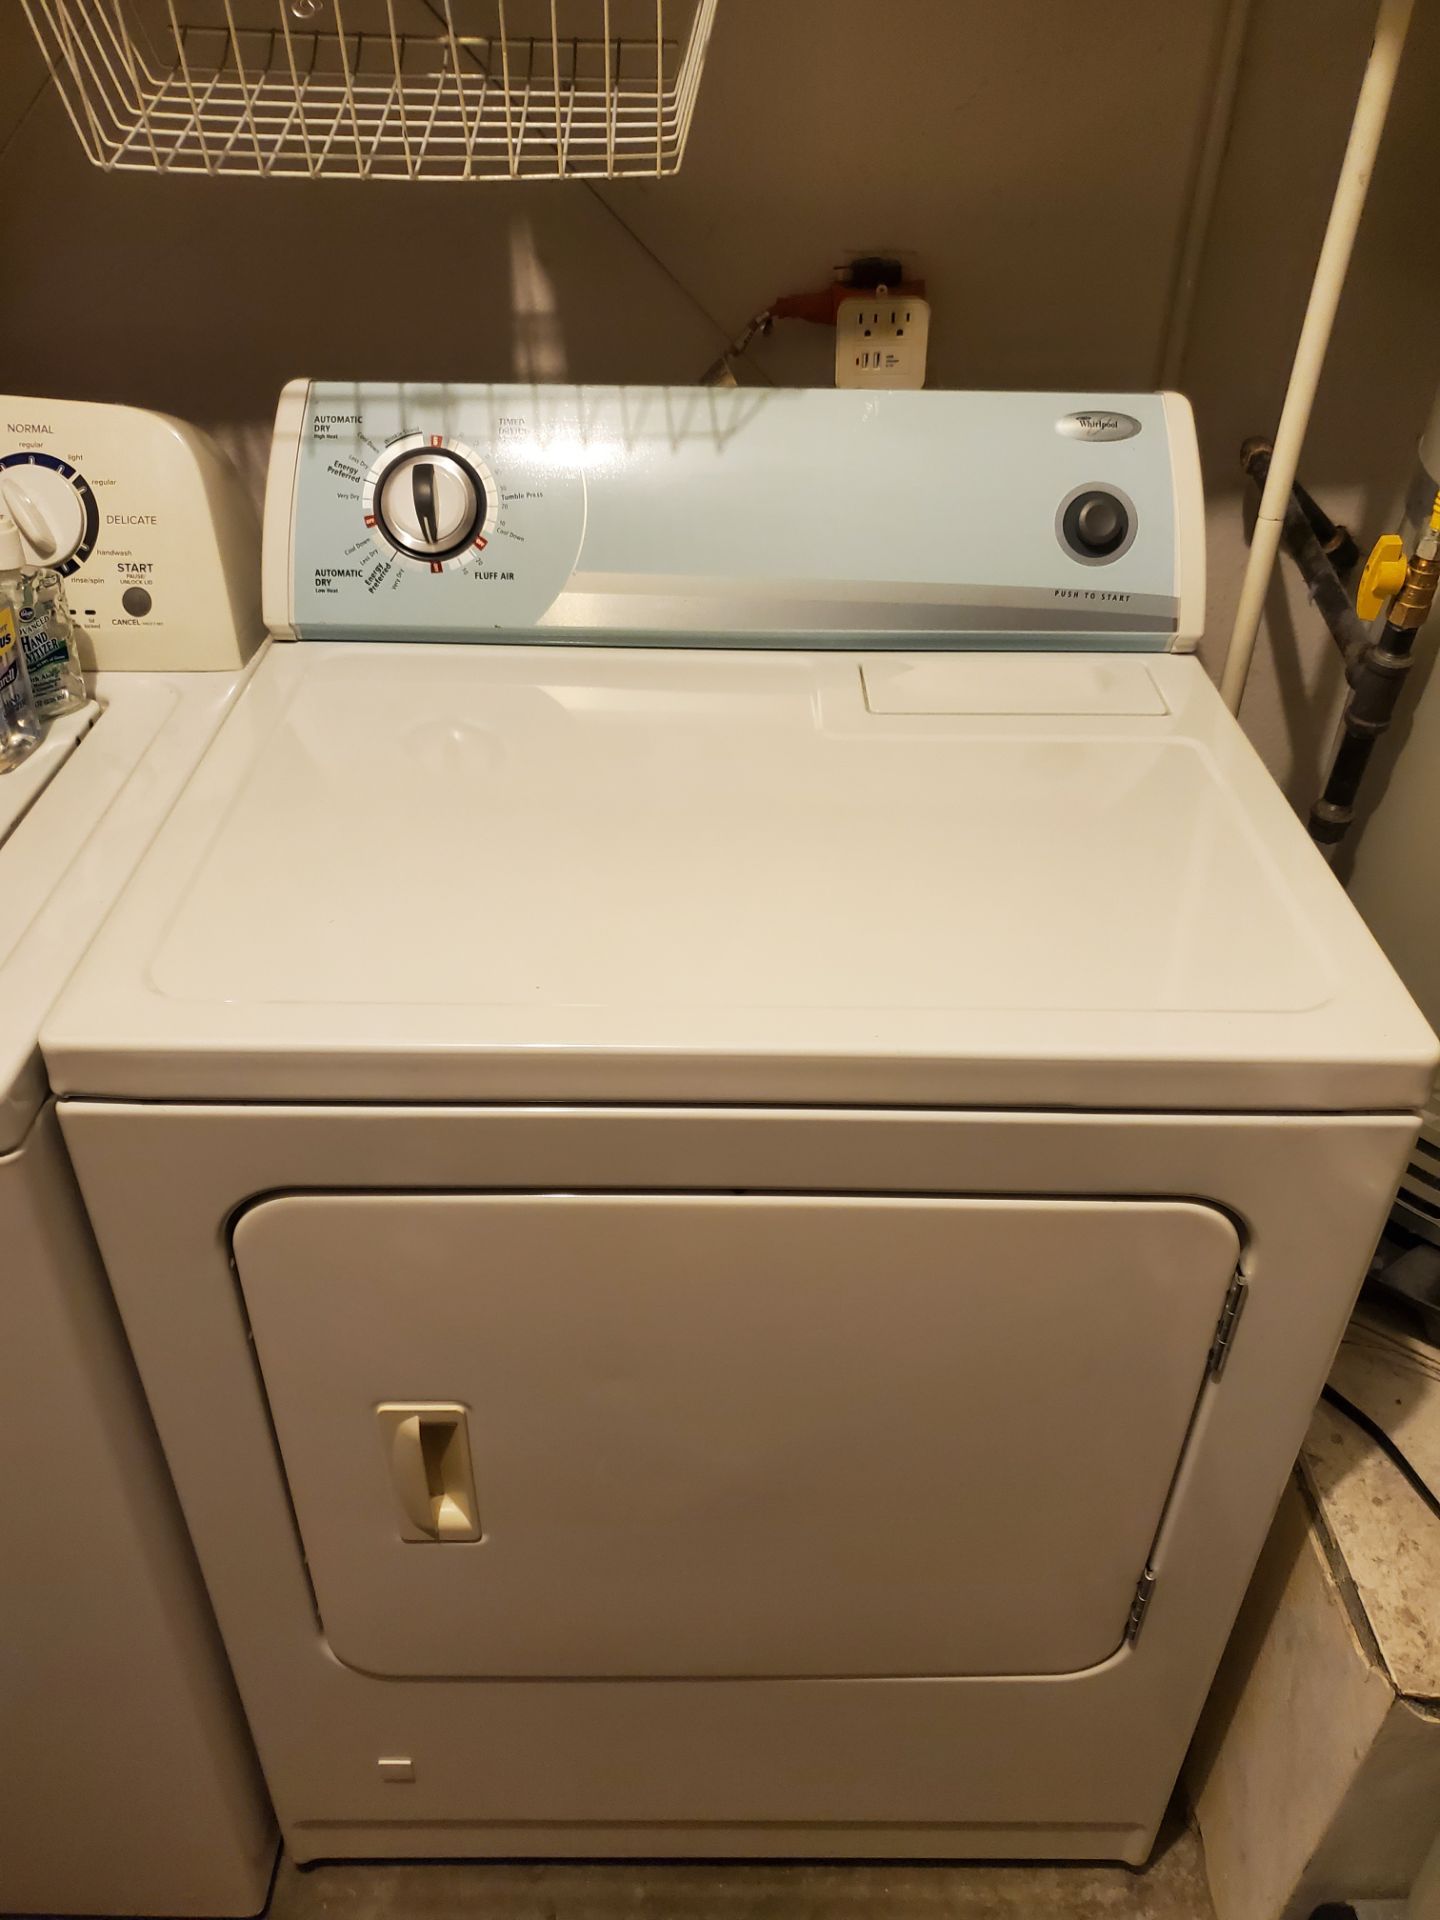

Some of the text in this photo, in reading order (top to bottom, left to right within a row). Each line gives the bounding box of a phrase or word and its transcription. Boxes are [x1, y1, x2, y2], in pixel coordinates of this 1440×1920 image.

[314, 415, 363, 424] AUTOMATIC
[1079, 418, 1118, 430] Whirlpool
[7, 423, 54, 434] NORMAL
[19, 441, 43, 449] regular
[68, 454, 83, 462] light
[333, 460, 359, 475] Energy
[327, 465, 361, 483] Preferred
[106, 515, 157, 525] DELICATE
[97, 549, 133, 557] handwash
[117, 562, 153, 573] START
[314, 569, 363, 578] AUTOMATIC
[364, 562, 384, 586] Energy
[368, 562, 392, 594] Preferred
[474, 571, 515, 580] FLUFF AIR
[71, 577, 105, 585] rinse/spin
[314, 578, 331, 587] DRY
[1054, 590, 1079, 599] PUSH
[1101, 593, 1131, 602] START
[112, 618, 140, 626] CANCEL
[21, 631, 48, 653] HAND
